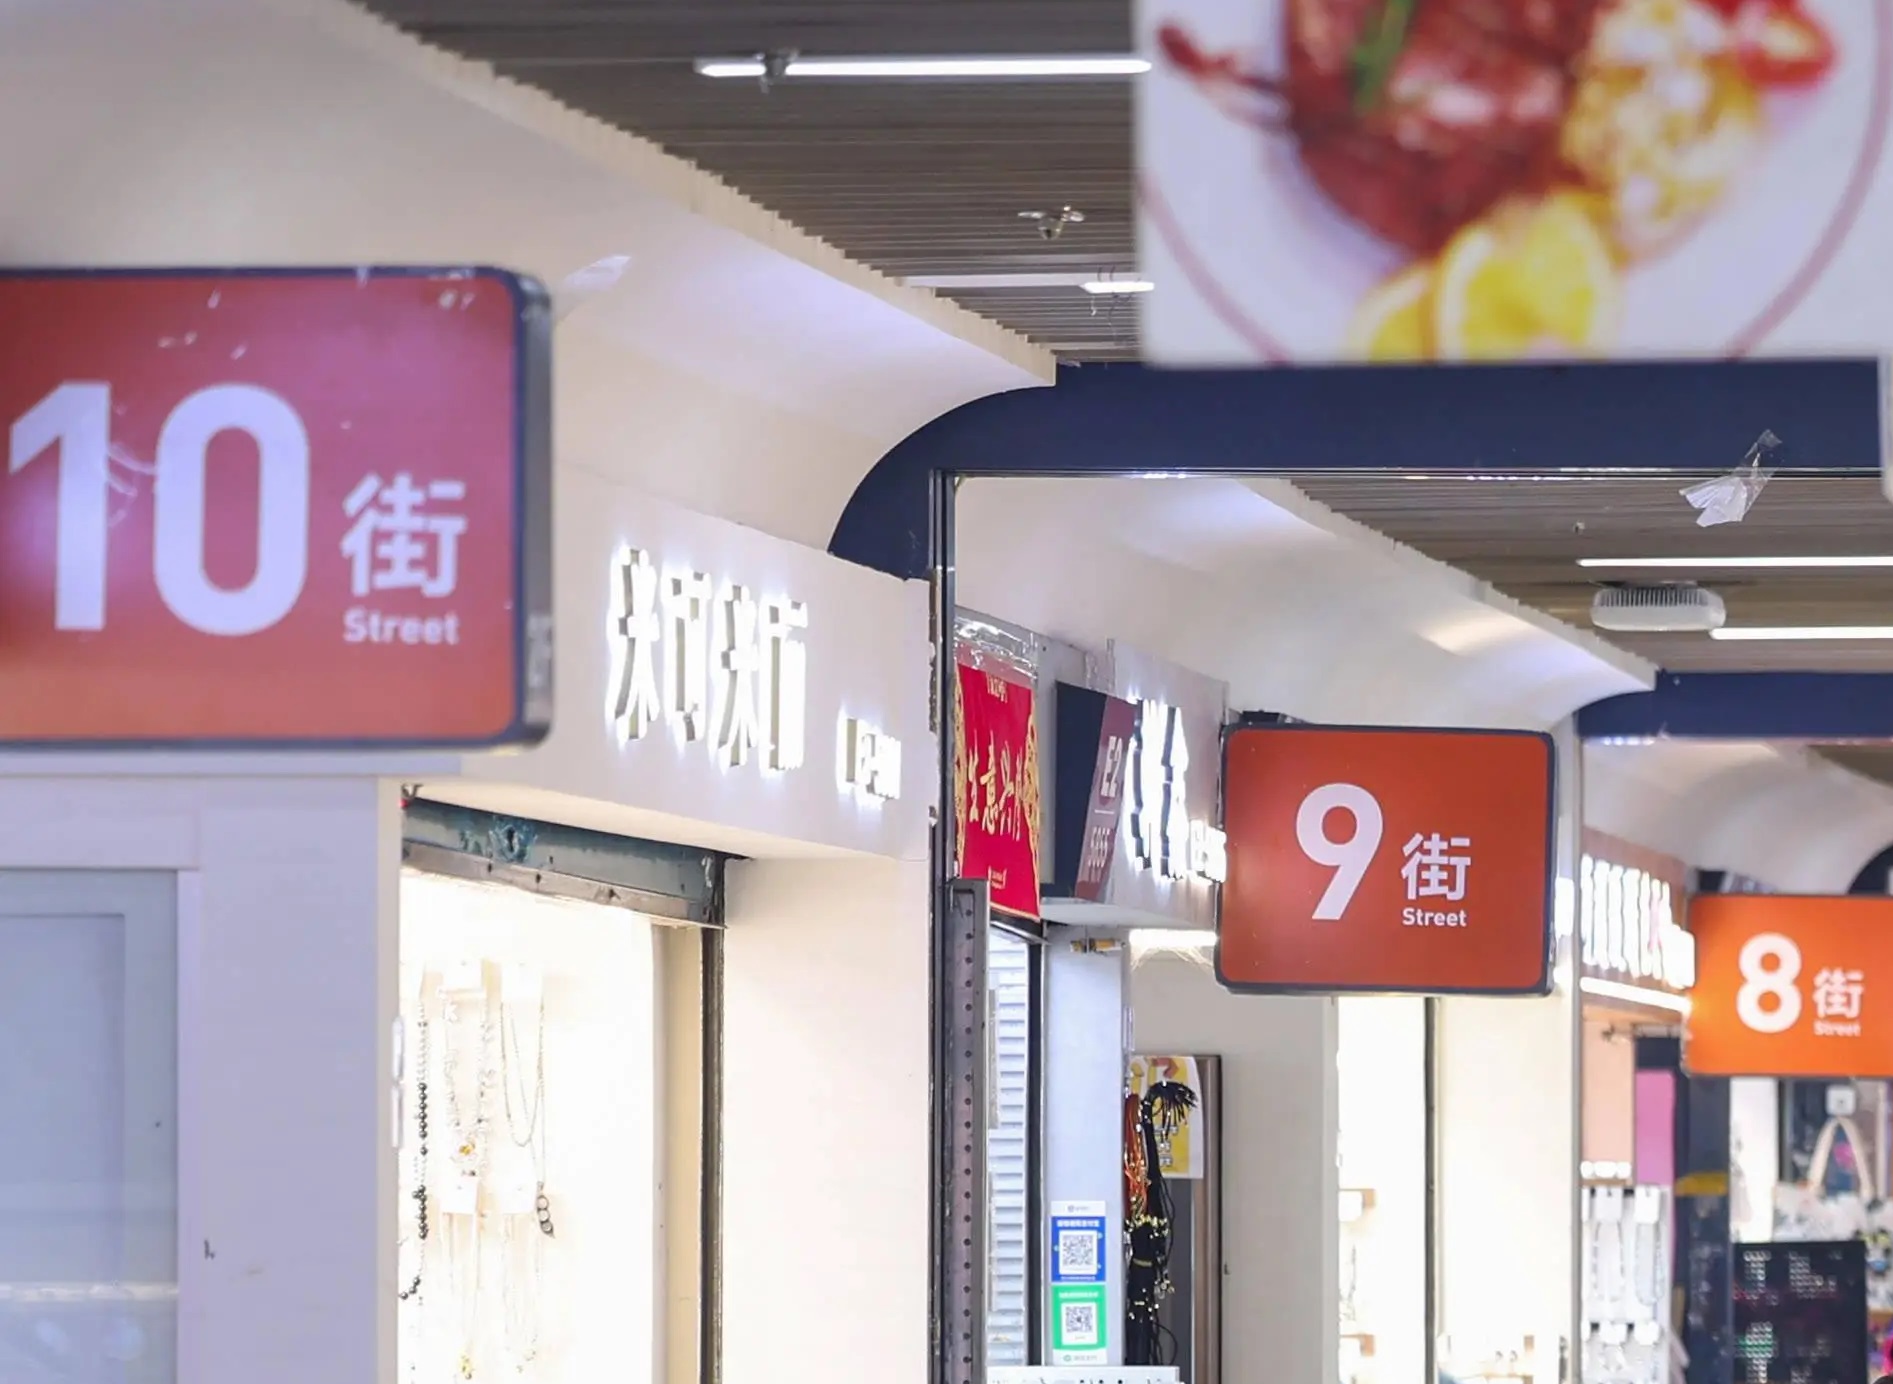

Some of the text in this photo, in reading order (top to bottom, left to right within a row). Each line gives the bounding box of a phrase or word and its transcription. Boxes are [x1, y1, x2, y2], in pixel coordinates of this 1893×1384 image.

[8, 381, 468, 638] 10 街
[343, 607, 460, 648] Street
[1295, 782, 1384, 921] 9
[1400, 832, 1472, 902] 街
[1402, 907, 1467, 928] Street
[1735, 932, 1803, 1034] 8
[1812, 967, 1865, 1020] 街
